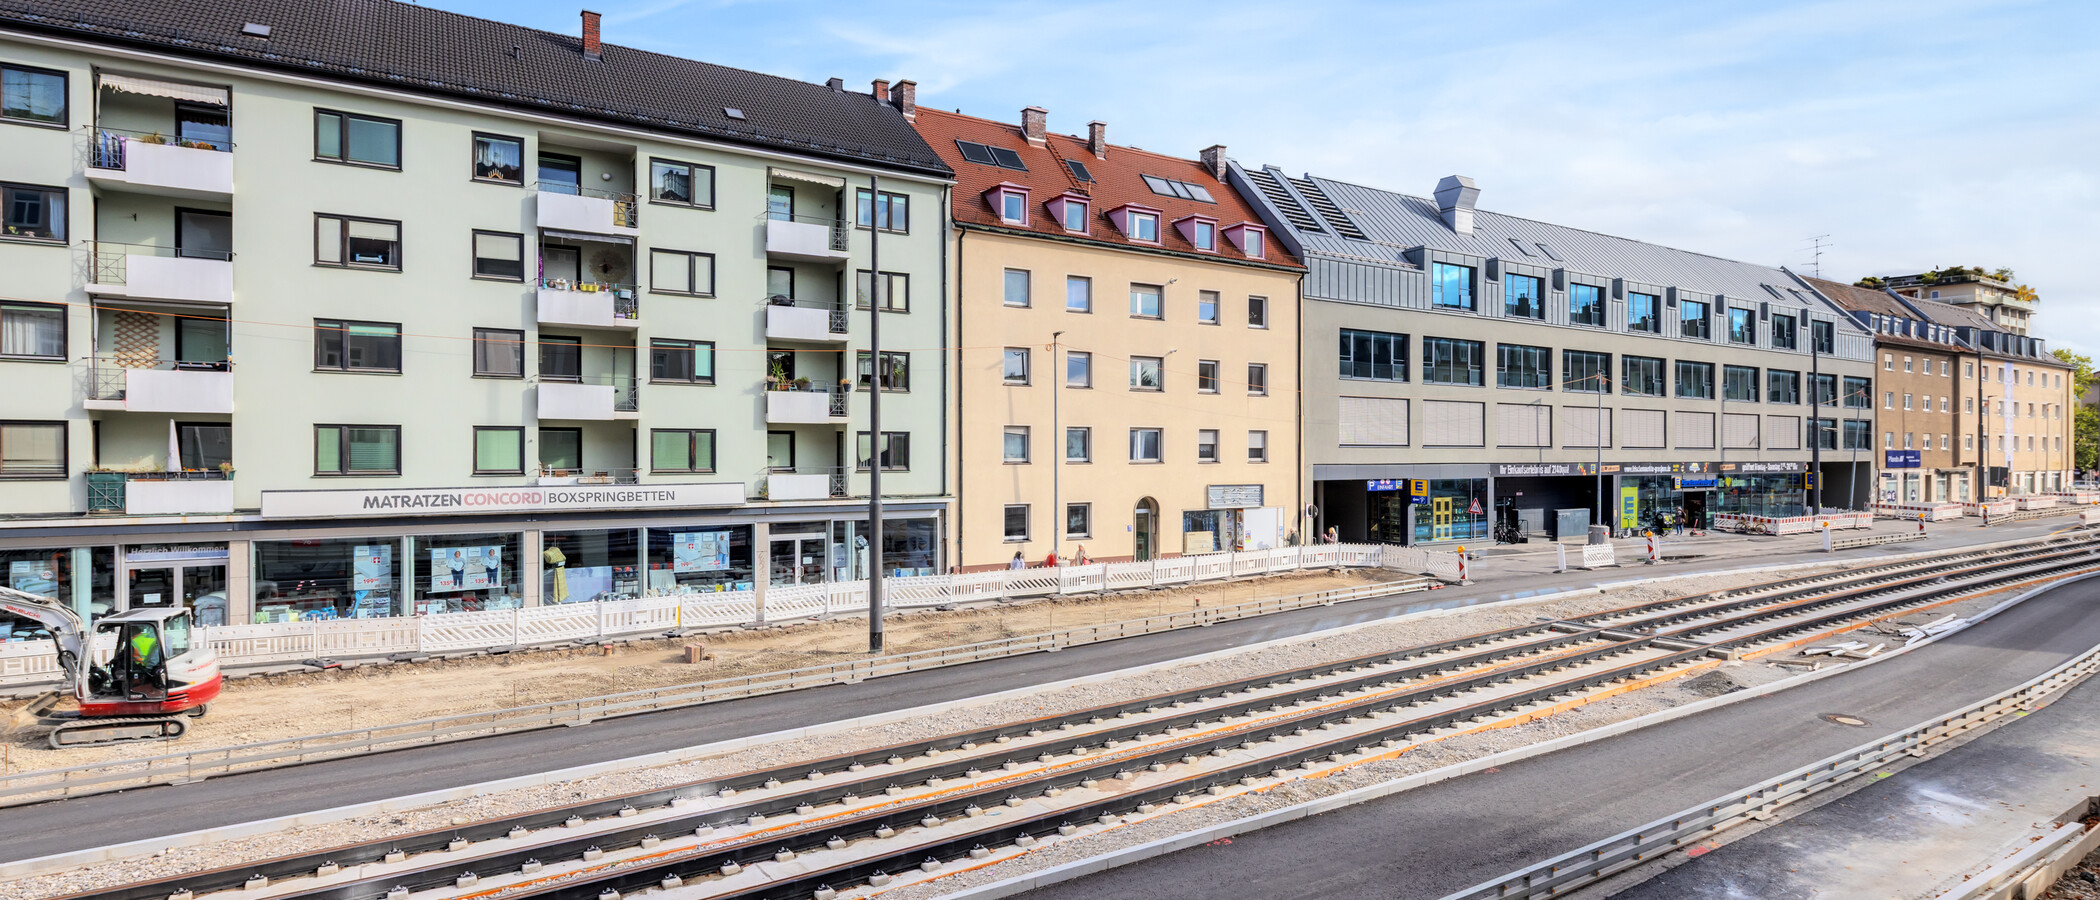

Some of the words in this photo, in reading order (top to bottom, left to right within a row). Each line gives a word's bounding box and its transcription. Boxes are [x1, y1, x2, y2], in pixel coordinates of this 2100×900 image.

[1369, 481, 1375, 490] P
[1415, 481, 1423, 491] E
[363, 493, 462, 509] MATRATZEN
[464, 491, 542, 506] CONCORD
[548, 490, 675, 504] BOXSPRINGBETTEN
[1624, 496, 1634, 514] E
[131, 546, 168, 555] Herzlich
[170, 545, 225, 554] Willkommen
